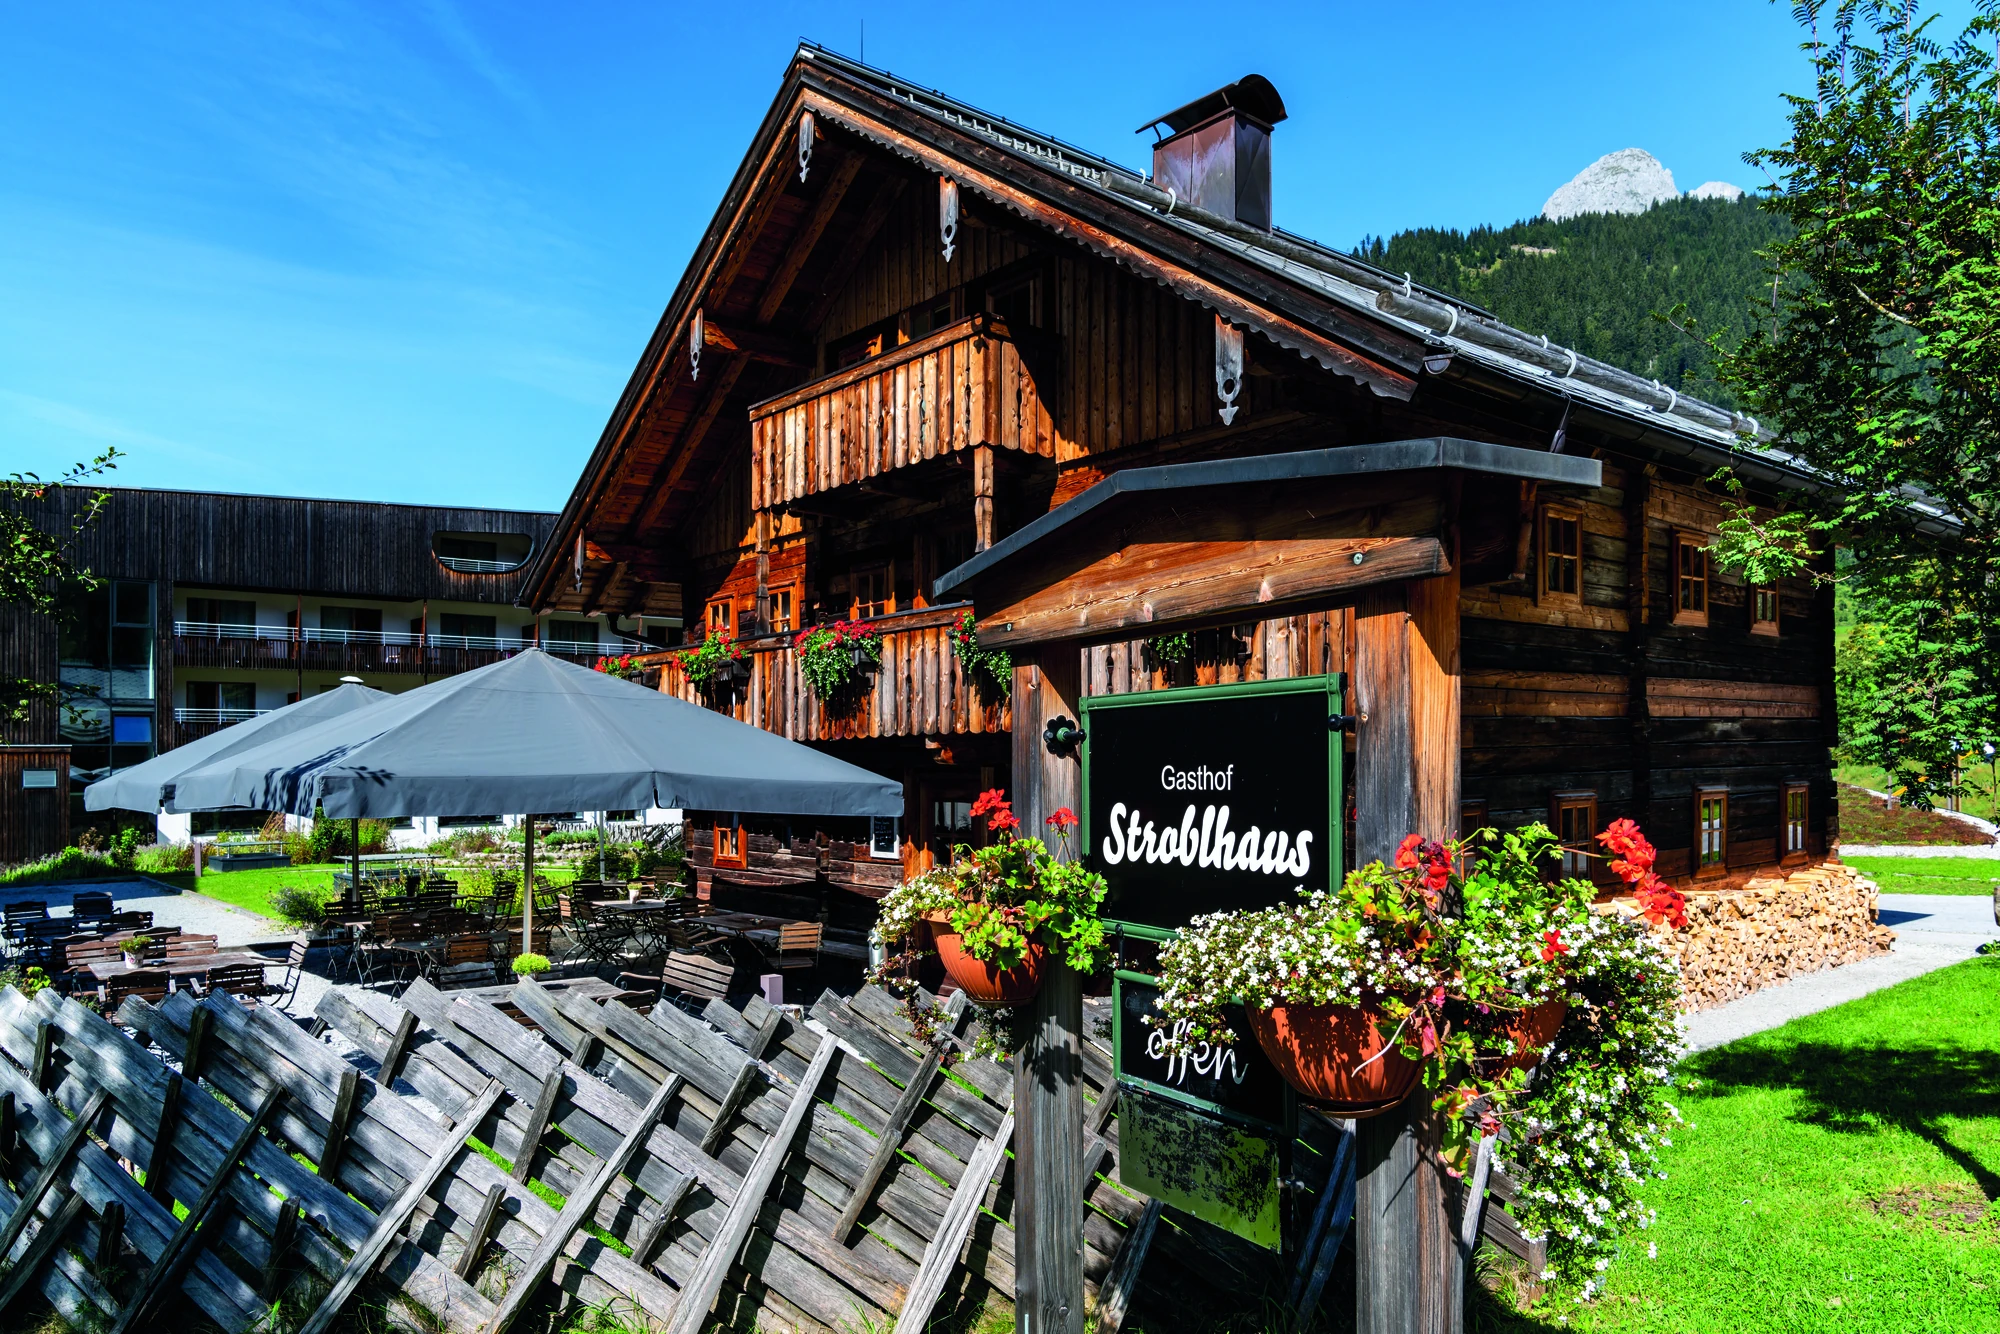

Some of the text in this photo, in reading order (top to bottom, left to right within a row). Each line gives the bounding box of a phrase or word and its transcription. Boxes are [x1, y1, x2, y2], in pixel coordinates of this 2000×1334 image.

[1161, 764, 1233, 790] Gasthof
[1102, 802, 1313, 877] Stroblhaus
[1145, 1018, 1249, 1085] offen
